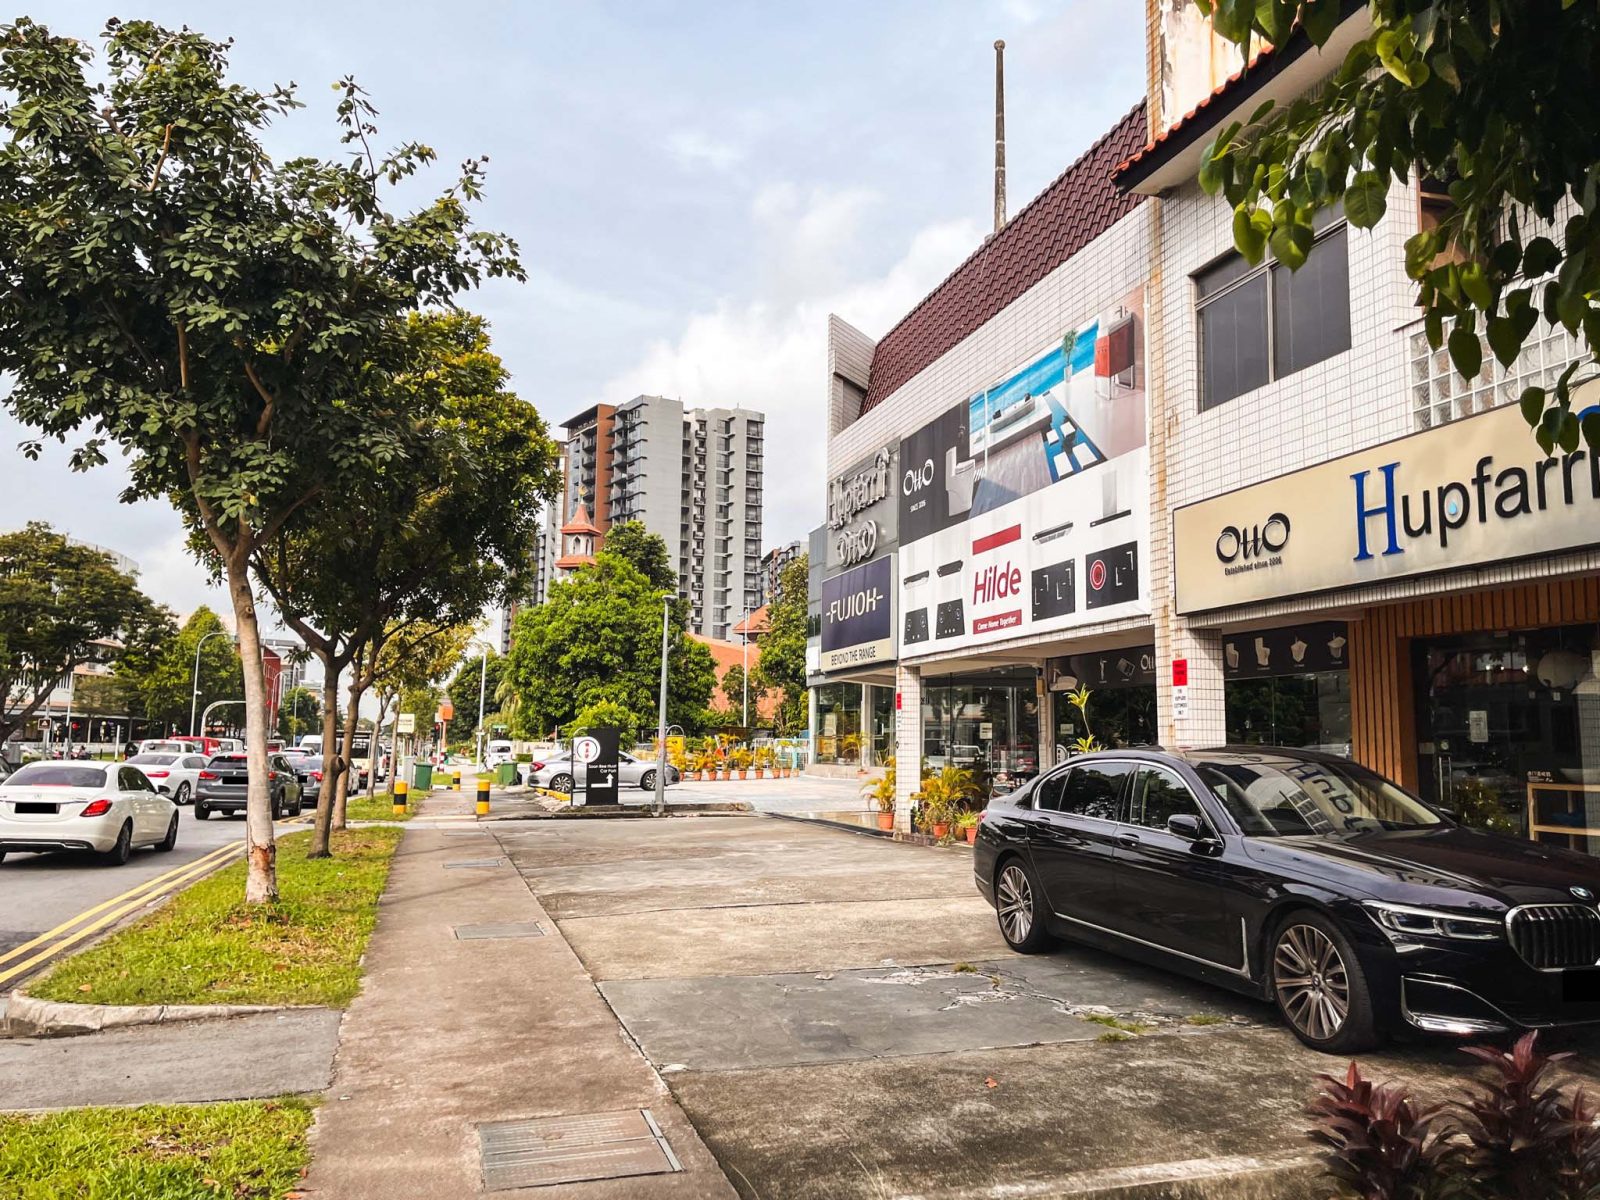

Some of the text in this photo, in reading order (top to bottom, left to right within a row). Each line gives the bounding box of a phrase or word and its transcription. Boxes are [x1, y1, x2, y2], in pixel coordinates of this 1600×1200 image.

[1224, 562, 1253, 576] Established
[1254, 560, 1268, 570] since
[973, 560, 1022, 606] Hilde
[831, 646, 876, 666] BEYOND THE RANGE
